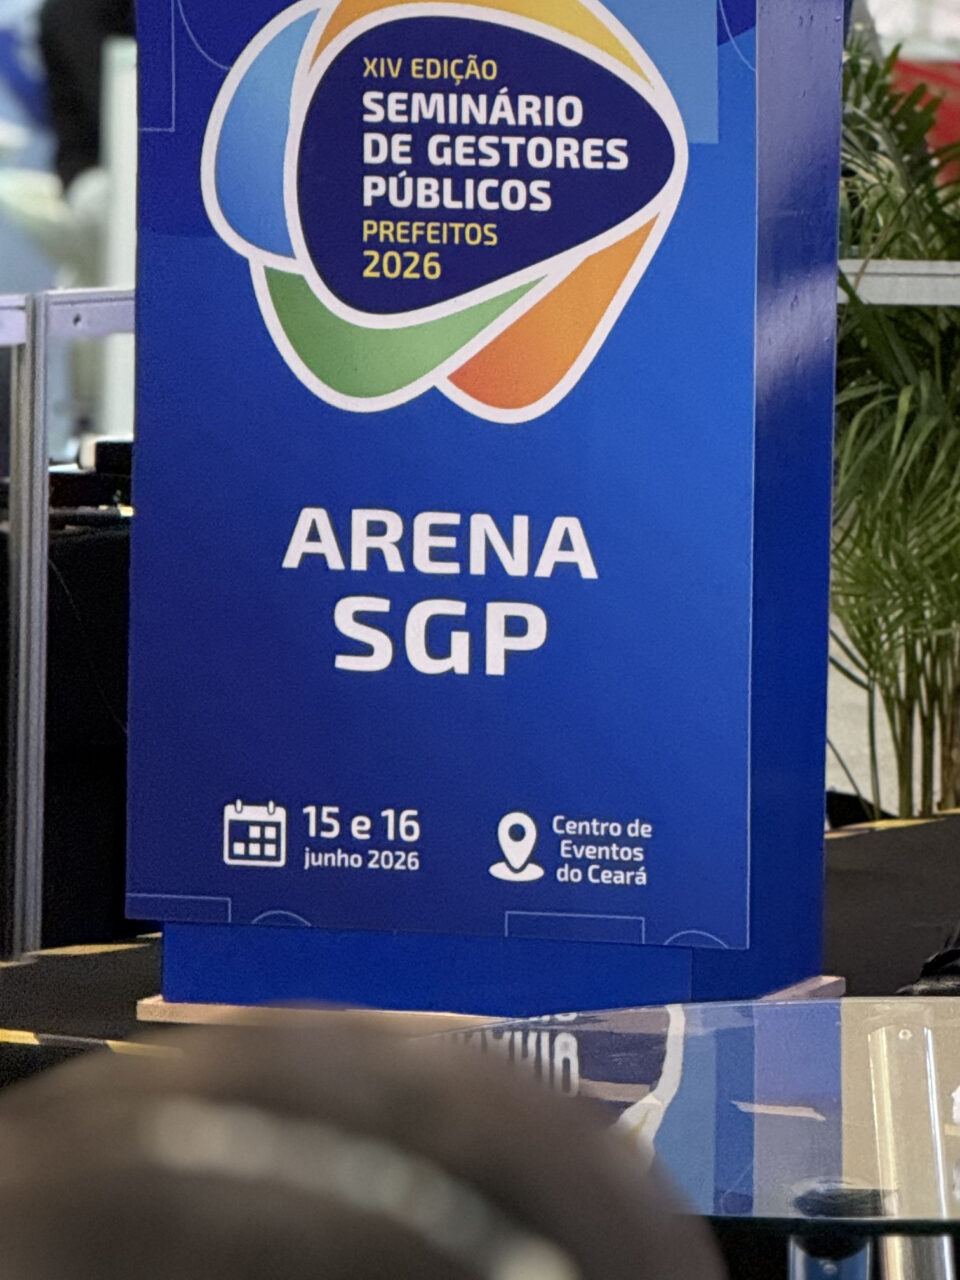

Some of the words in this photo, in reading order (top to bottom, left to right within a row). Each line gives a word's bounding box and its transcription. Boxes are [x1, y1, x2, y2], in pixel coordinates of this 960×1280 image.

[363, 57, 402, 78] XIV
[412, 54, 498, 85] EDIÇÃO
[363, 87, 583, 127] SEMINÁRIO
[363, 133, 412, 165] DE
[428, 134, 629, 170] GESTORES
[363, 171, 551, 212] PÚBLICOS
[362, 220, 498, 246] PREFEITOS
[363, 251, 441, 280] 2026
[282, 508, 598, 579] ARENA
[334, 596, 548, 676] SGP
[303, 806, 340, 839] 15
[351, 816, 371, 840] e
[381, 809, 420, 842] 16
[552, 815, 621, 838] Centro
[626, 818, 653, 838] de
[304, 847, 362, 870] junho
[367, 850, 420, 871] 2026
[560, 840, 644, 861] Eventos
[556, 864, 582, 883] do
[587, 863, 647, 886] Ceará
